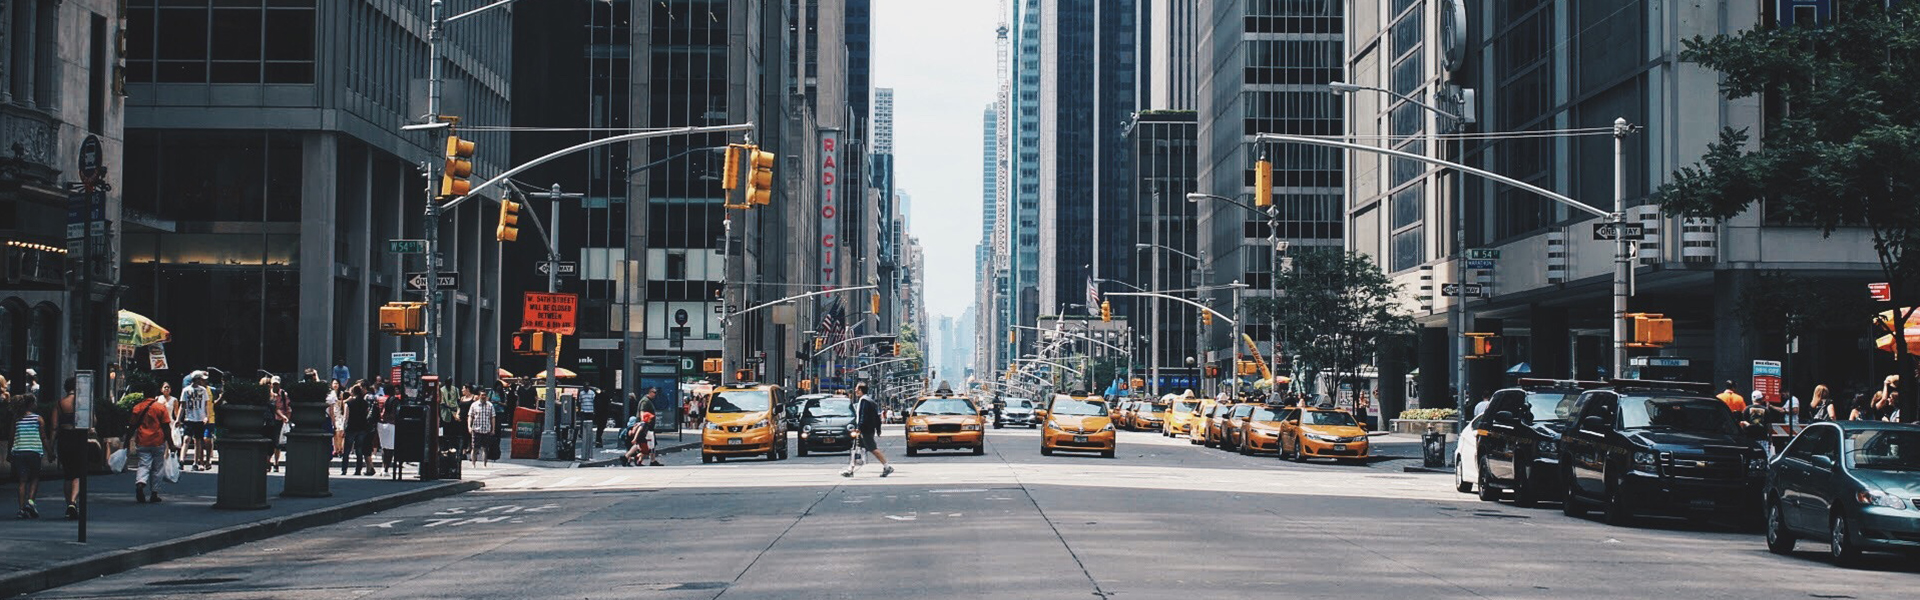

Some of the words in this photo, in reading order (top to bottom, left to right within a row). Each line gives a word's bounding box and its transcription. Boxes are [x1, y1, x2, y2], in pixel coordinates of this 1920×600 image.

[823, 138, 835, 219] RADIO
[1626, 228, 1637, 236] AY
[391, 242, 398, 252] W
[399, 242, 409, 252] 54
[1482, 250, 1492, 259] 54
[823, 234, 834, 298] CITY
